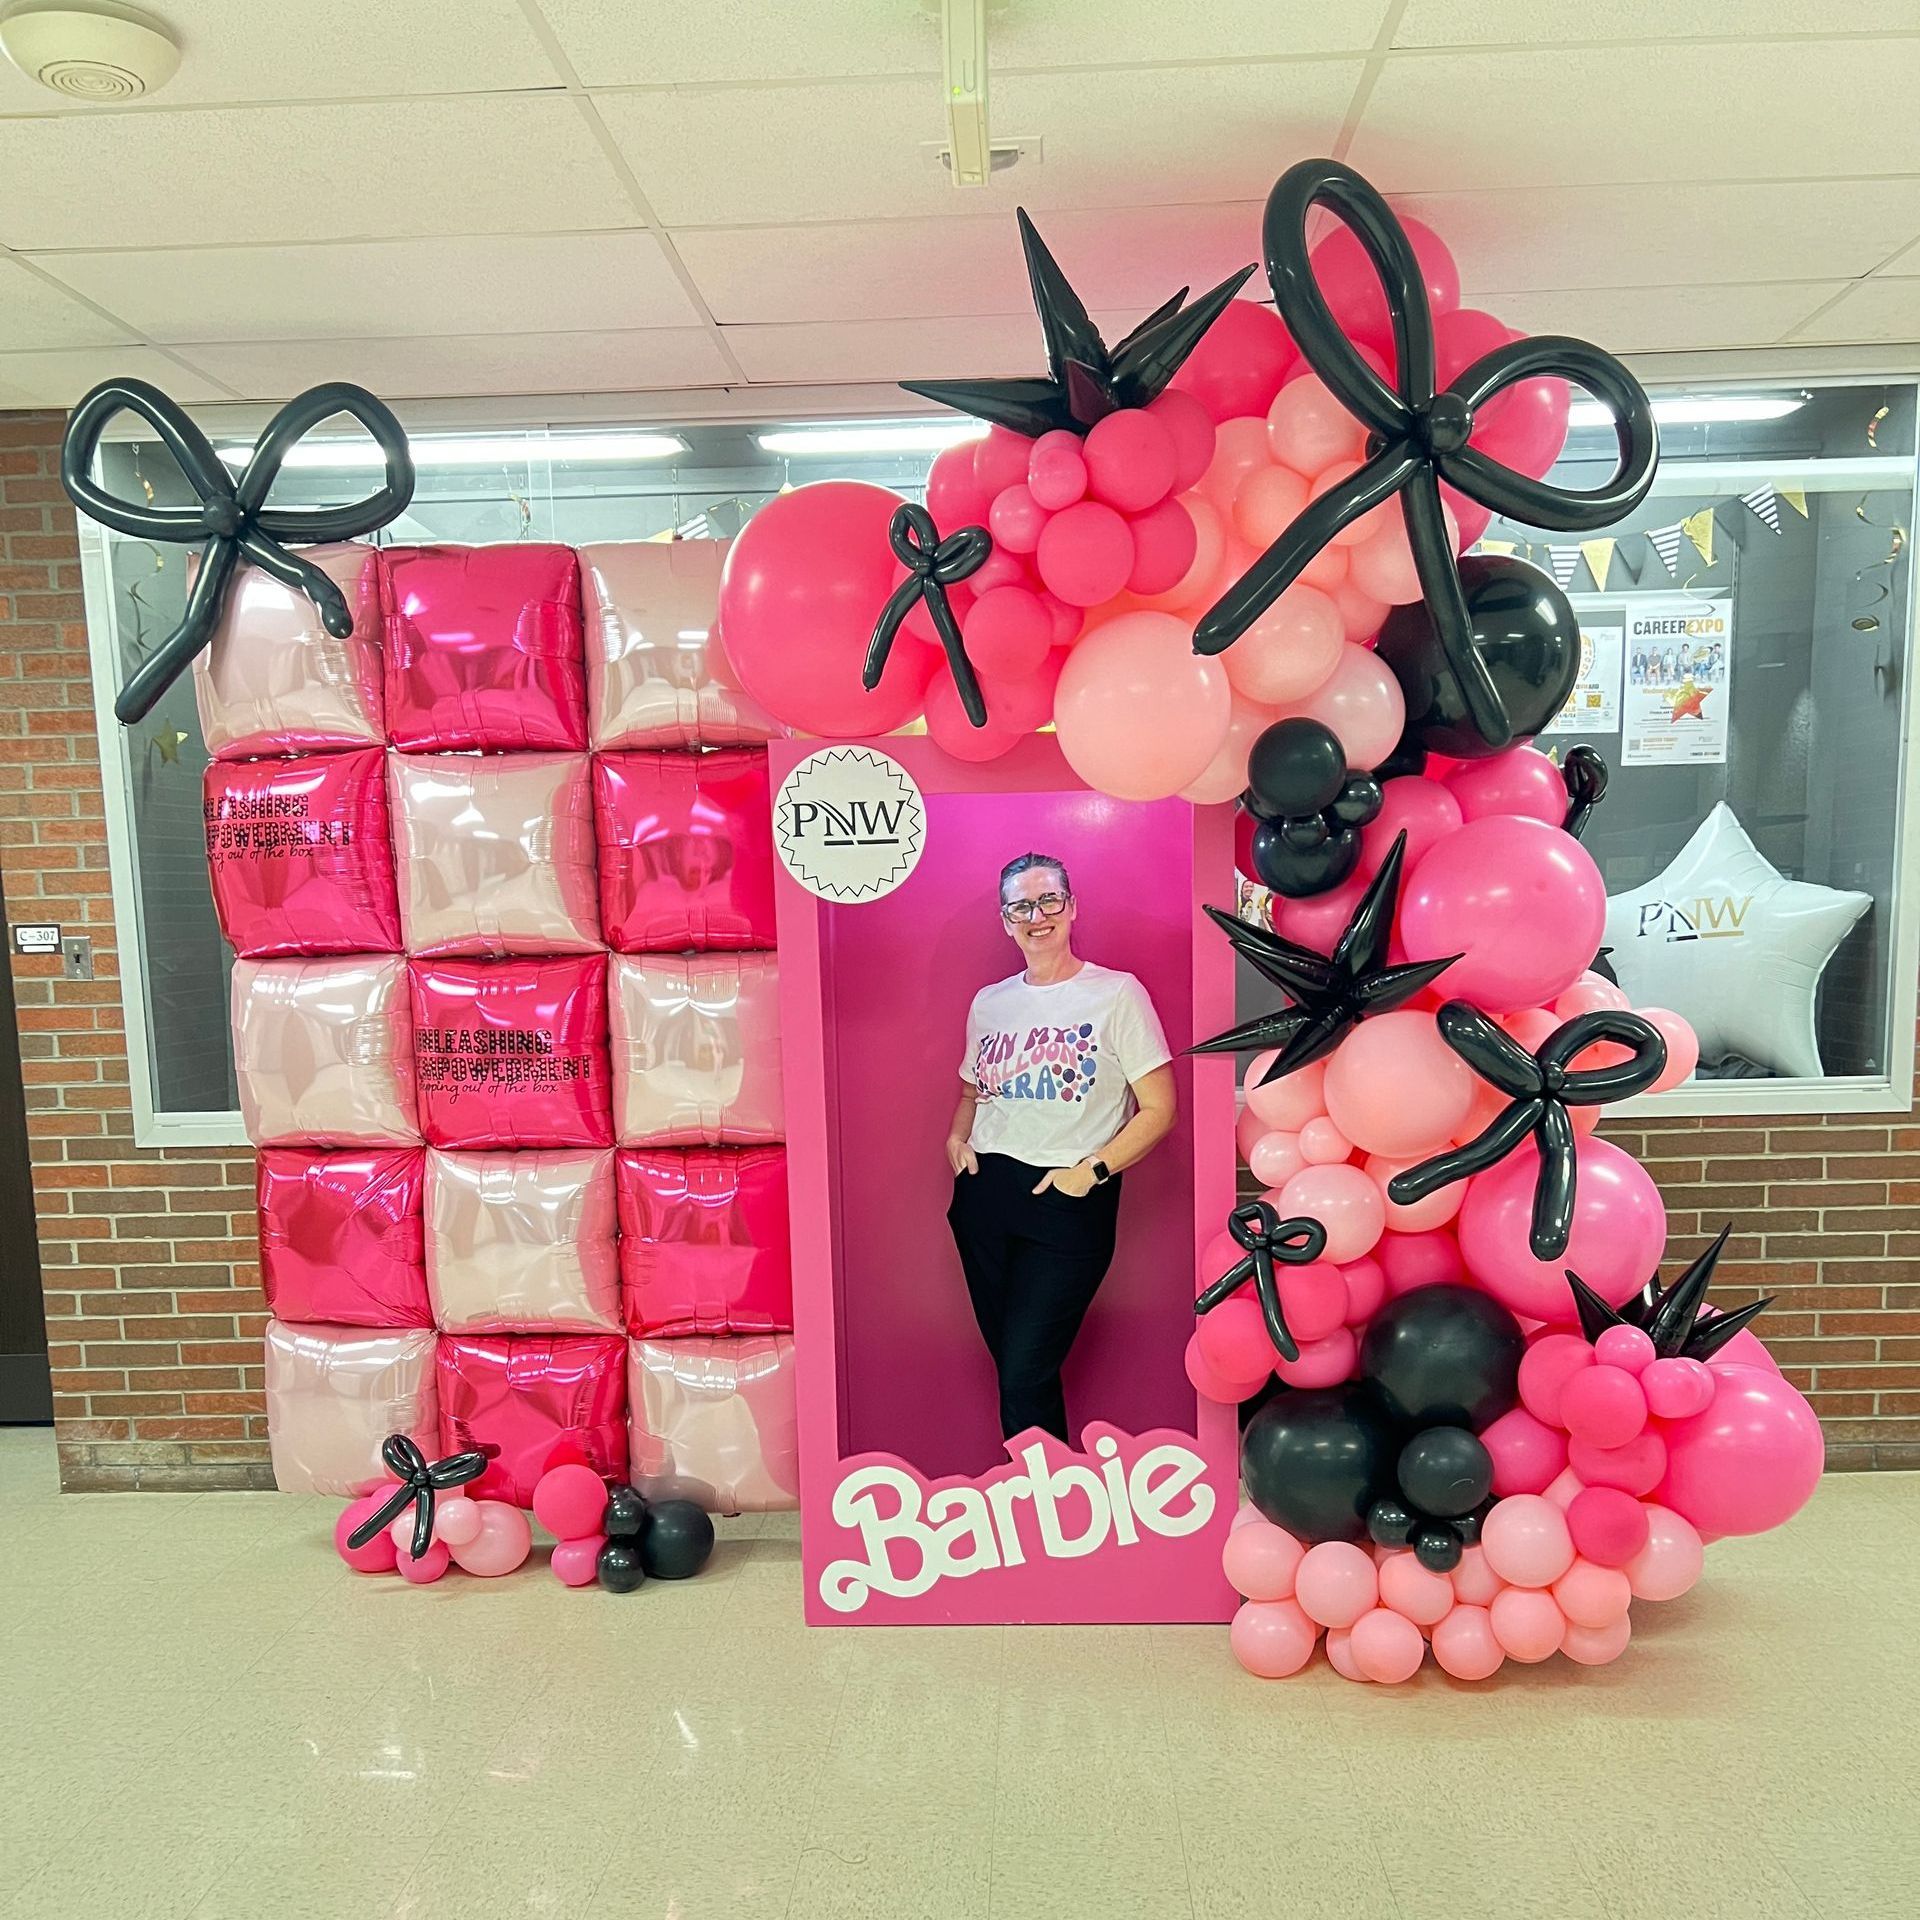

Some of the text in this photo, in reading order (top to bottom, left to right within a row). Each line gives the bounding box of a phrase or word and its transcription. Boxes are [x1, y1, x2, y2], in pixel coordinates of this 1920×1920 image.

[792, 800, 907, 837] PNW
[228, 848, 246, 860] out
[250, 846, 262, 864] of
[264, 844, 284, 859] the
[289, 842, 314, 858] box
[1637, 896, 1754, 937] PNW
[20, 931, 55, 941] C-307
[1024, 1027, 1071, 1052] MY
[979, 1042, 1078, 1092] BALLOON
[1002, 1065, 1057, 1100] ERA
[462, 1081, 484, 1093] out
[488, 1080, 500, 1097] of
[504, 1077, 526, 1093] the
[532, 1077, 558, 1093] box
[819, 1436, 1216, 1612] Barbie
